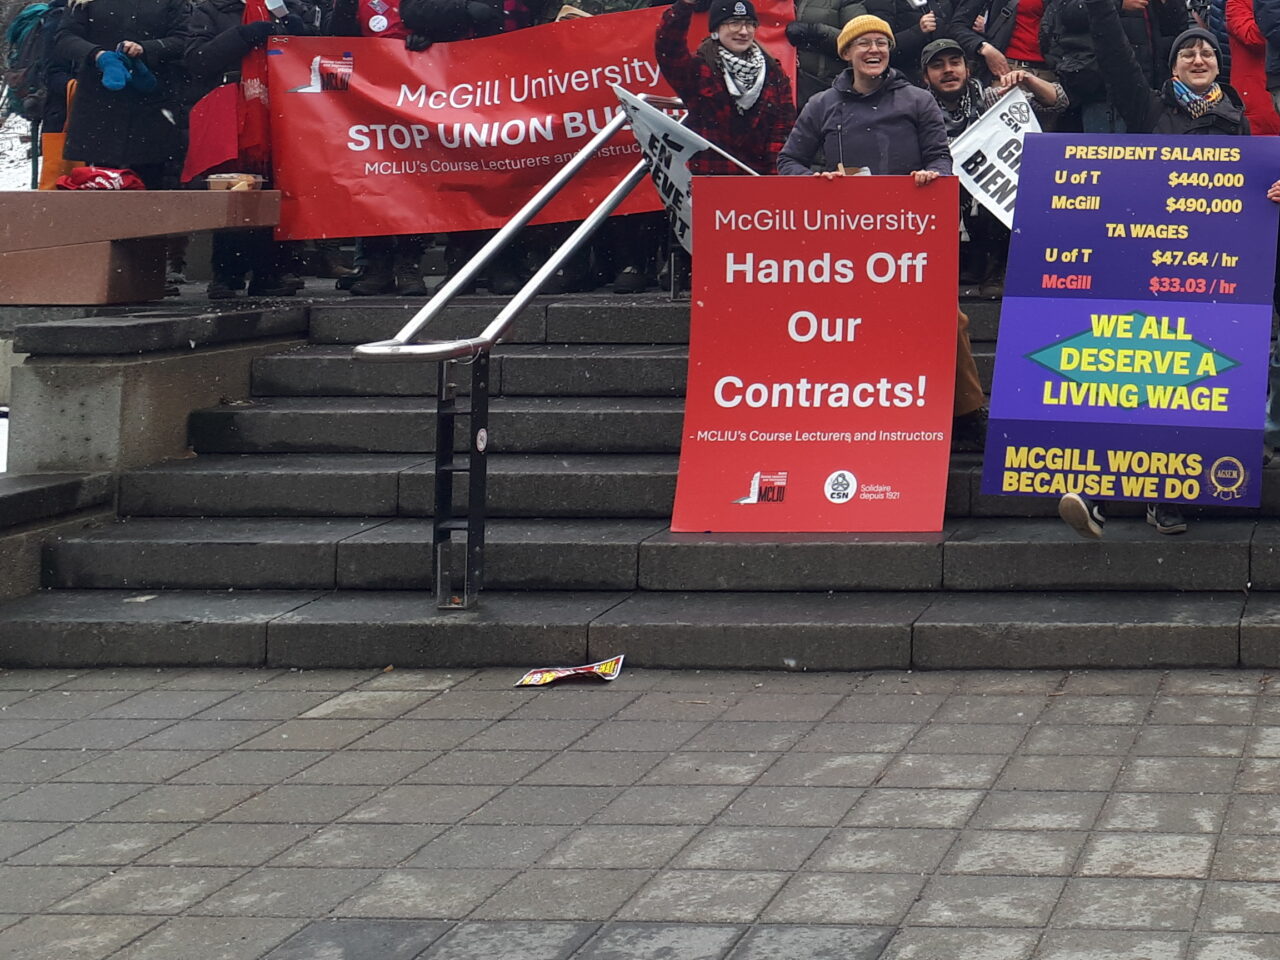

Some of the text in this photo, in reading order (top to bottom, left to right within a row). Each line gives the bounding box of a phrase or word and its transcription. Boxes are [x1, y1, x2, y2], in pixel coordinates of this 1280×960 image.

[396, 56, 661, 110] McGill University
[348, 123, 429, 152] STOP
[438, 115, 555, 149] UNION
[999, 112, 1021, 133] CSN
[365, 159, 428, 175] MCLIU's
[431, 157, 479, 172] Course
[482, 153, 550, 171] Lecturers
[1064, 146, 1240, 162] PRESIDENT SALARIES
[1054, 171, 1244, 188] U of T $440,000
[1051, 196, 1242, 214] McGill $490,000
[714, 210, 796, 231] McGill
[804, 209, 937, 235] University:
[1106, 224, 1188, 239] TA WAGES
[726, 252, 927, 283] Hands Off
[1045, 248, 1058, 262] U
[1061, 248, 1078, 263] of
[1081, 249, 1092, 263] T
[1152, 250, 1209, 267] $47.64
[1222, 253, 1238, 268] hr
[1042, 275, 1091, 290] McGill
[1149, 276, 1206, 294] $33.03
[1219, 280, 1236, 294] hr
[787, 310, 862, 342] Our
[1090, 314, 1192, 340] WE ALL
[1060, 347, 1217, 376] DESERVE A
[714, 376, 927, 408] Contracts!
[1043, 381, 1229, 411] LIVING WAGE
[697, 430, 747, 442] MCLIU's
[749, 430, 792, 441] Course
[795, 430, 851, 441] Lecturers
[854, 430, 877, 441] and
[879, 430, 944, 441] Instructors
[1005, 446, 1203, 476] MCGILL WORKS
[830, 492, 849, 500] CSN
[860, 492, 900, 501] depuis 1921
[861, 484, 891, 492] Solidaire
[1002, 471, 1200, 500] BECAUSE WE DO
